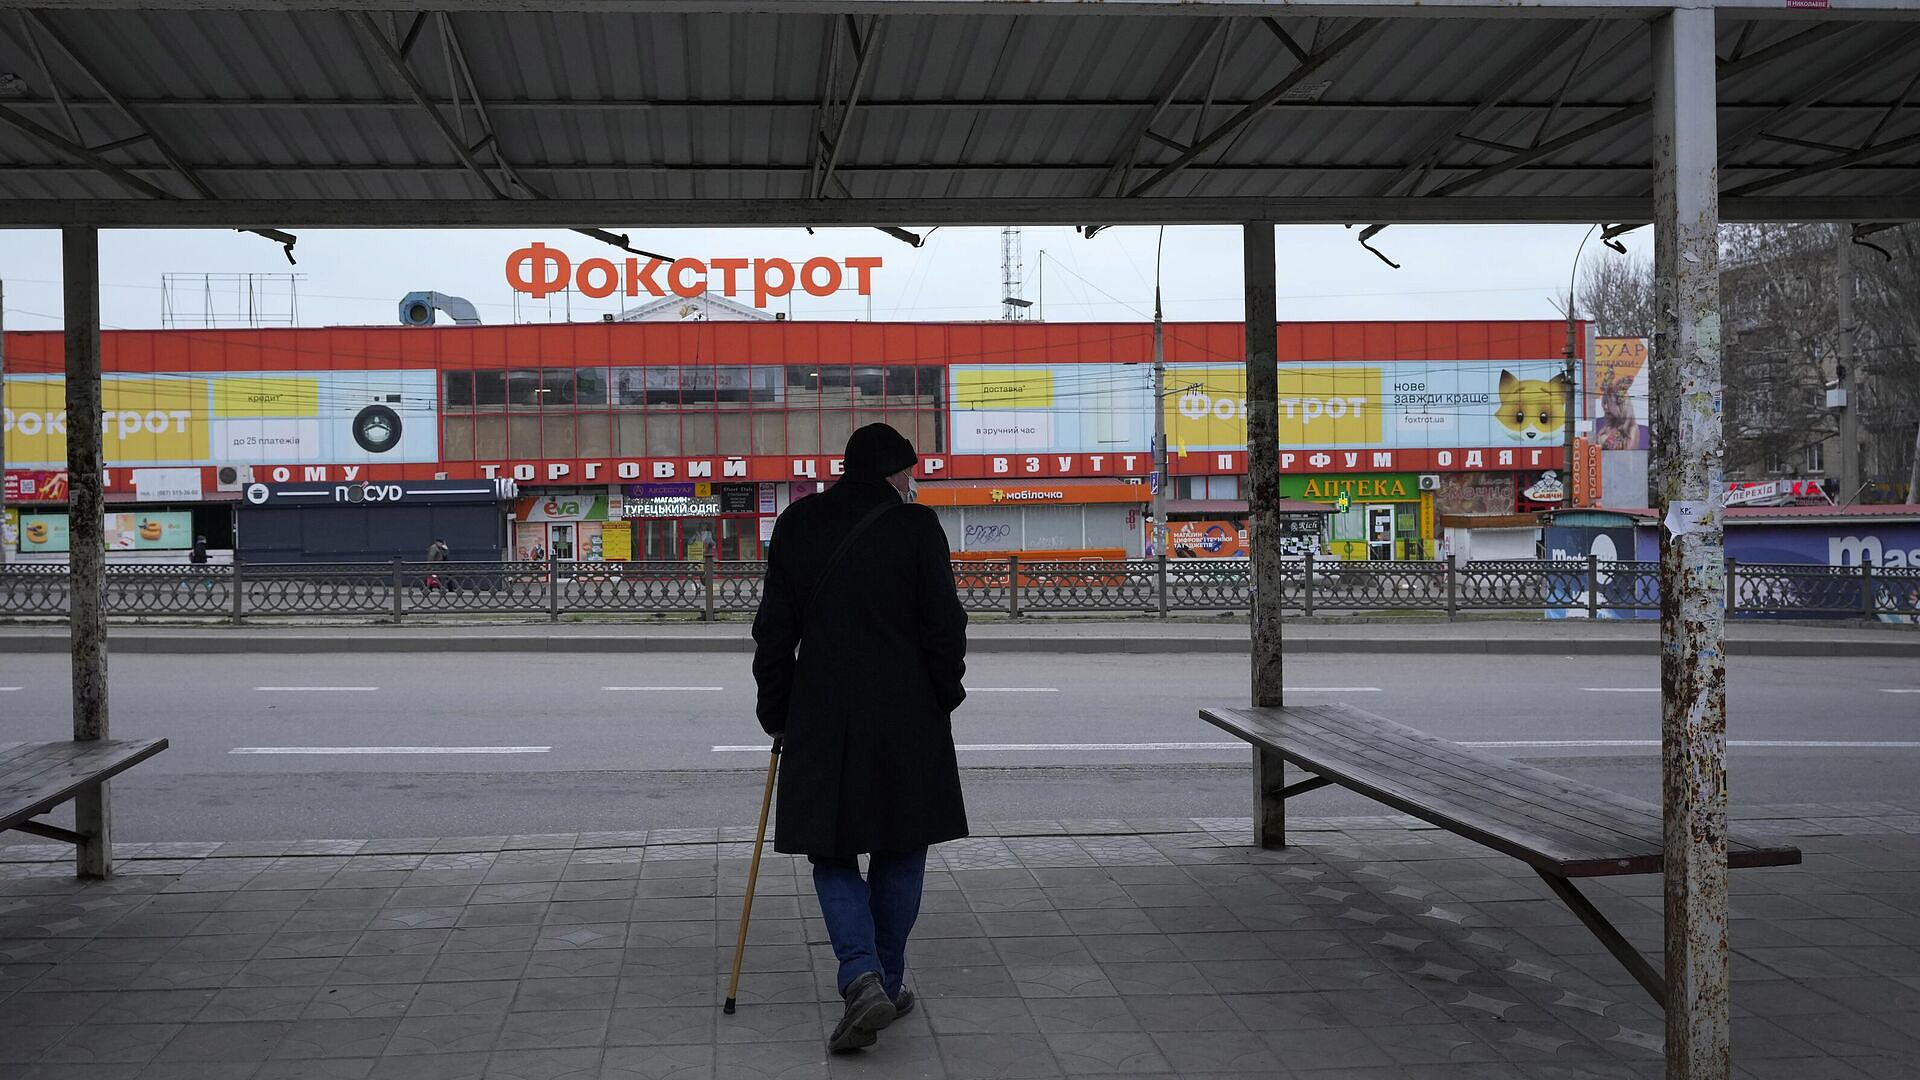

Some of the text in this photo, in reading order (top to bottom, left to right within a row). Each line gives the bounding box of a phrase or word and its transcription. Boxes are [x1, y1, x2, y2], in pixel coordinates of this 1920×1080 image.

[505, 242, 883, 308] Фокстрот
[1394, 382, 1425, 392] нове
[1394, 394, 1489, 406] завжди краще
[1178, 394, 1368, 424] Фотрот
[4, 410, 191, 440] октрот
[1404, 415, 1445, 424] foxtrot.ua
[246, 436, 257, 446] 25
[1218, 452, 1392, 469] ПРФУМ
[1437, 449, 1543, 469] ОДЯГ
[249, 465, 360, 482] ОМУ
[481, 456, 747, 480] ТОРГОВИЙ
[793, 458, 944, 479] ЦЕР
[1006, 489, 1063, 500] мобілочка
[1303, 478, 1407, 498] АПТЕКА
[653, 496, 688, 504] МАГАЗИН
[624, 503, 687, 516] ТУРЕЦЬКИЙ
